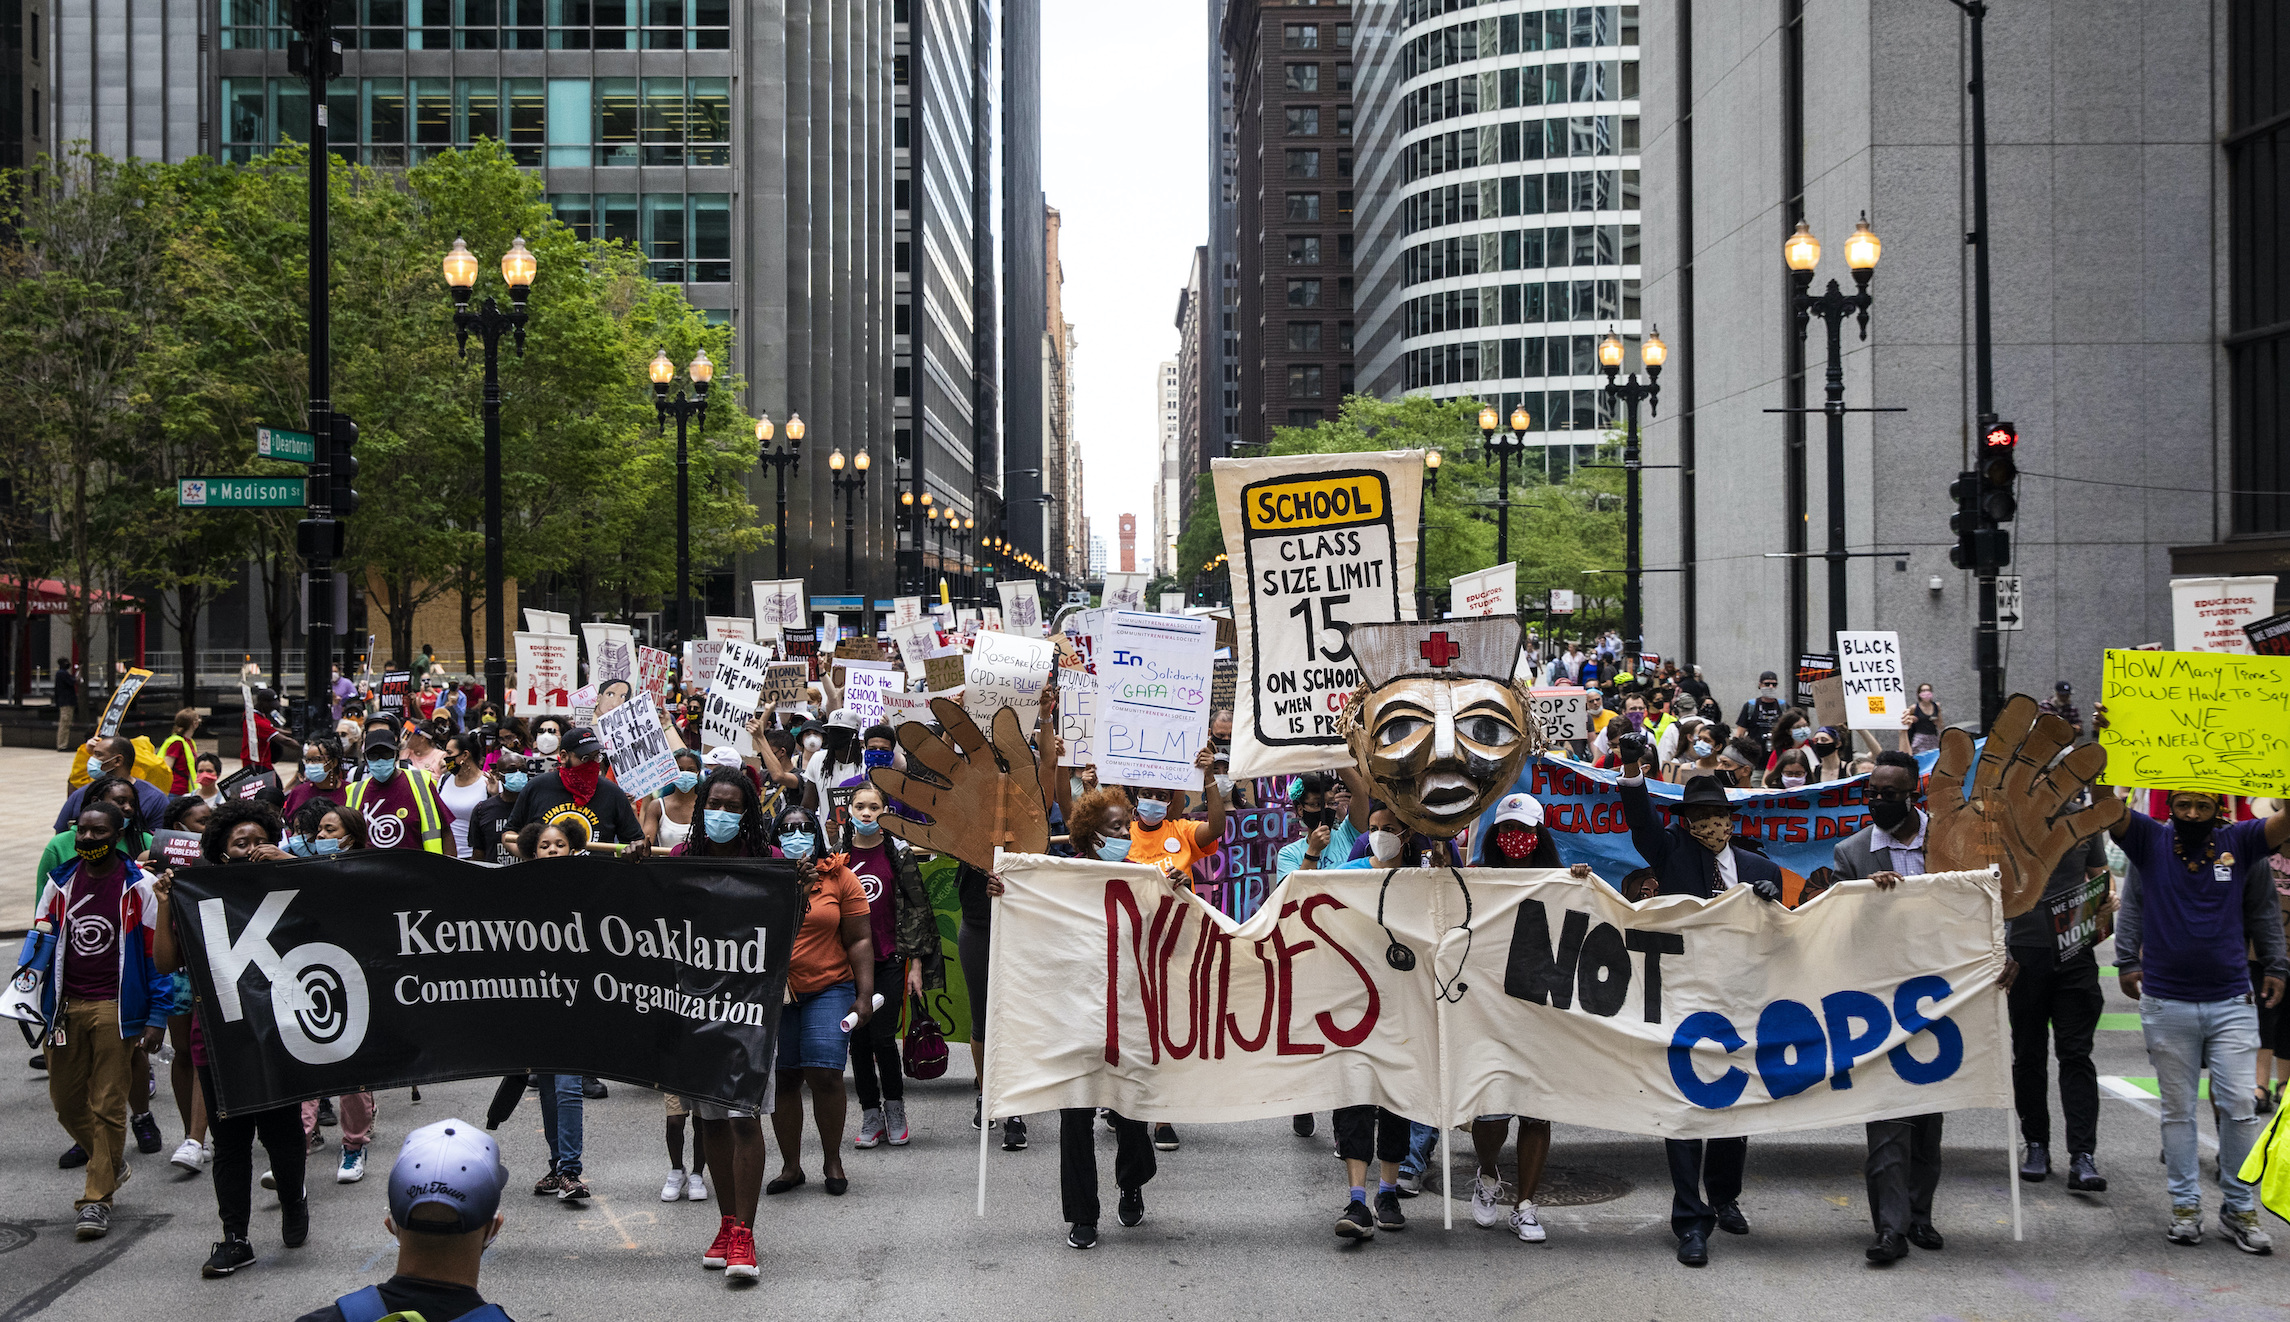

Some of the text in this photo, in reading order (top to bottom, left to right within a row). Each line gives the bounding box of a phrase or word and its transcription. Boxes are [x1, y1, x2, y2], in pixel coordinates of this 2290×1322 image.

[276, 434, 308, 455] Dearborn
[210, 483, 300, 500] W Madison St
[1257, 486, 1372, 524] SCHOOL
[1280, 531, 1361, 562] CLASS
[1263, 560, 1383, 596] SIZE LIMIT
[1998, 580, 2019, 592] ONE
[1466, 586, 1504, 603] EDUCATORS,
[1470, 596, 1502, 610] STUDENTS,
[1997, 596, 2020, 608] WAY
[2194, 597, 2256, 608] EDUCATORS,
[2199, 608, 2253, 618] STUDENTS,
[1290, 594, 1351, 662] 15
[2204, 629, 2246, 638] PARENTS
[2208, 640, 2243, 648] UNITED
[2252, 634, 2265, 642] WE
[786, 642, 814, 656] CPAC
[978, 636, 1014, 665] Roses
[1016, 660, 1029, 668] ARE
[1843, 640, 1895, 656] BLACK
[726, 641, 770, 676] WE HAVE
[1113, 650, 1143, 666] In
[1850, 660, 1895, 674] LIVES
[716, 664, 740, 690] THE
[854, 672, 892, 689] END the
[970, 668, 996, 686] CPD
[1013, 676, 1042, 690] BLUE
[1141, 661, 1204, 692] Solidarity
[2112, 654, 2282, 688] HOW Many Times
[382, 682, 408, 694] CPAC
[1267, 670, 1296, 694] ON
[1844, 677, 1903, 696] MATTER
[382, 694, 403, 707] NOW
[578, 690, 588, 699] NO
[848, 688, 879, 702] SCHOOL
[882, 694, 914, 708] EDUCATION
[974, 690, 998, 706] 33
[998, 696, 1041, 707] MILLION
[1123, 684, 1168, 698] GAPA
[1178, 687, 1204, 705] CPS
[2108, 681, 2289, 712] DO WE Have To Say
[1274, 696, 1312, 716] WHEN
[1289, 717, 1304, 734] IS
[2170, 708, 2228, 730] WE
[628, 719, 654, 740] the
[704, 720, 737, 745] BACK!
[1110, 724, 1202, 760] BLM!
[2262, 733, 2288, 752] in
[1122, 768, 1192, 782] GAPA NOW!
[246, 782, 256, 790] GOT
[833, 796, 846, 806] WE
[542, 802, 600, 826] JUNETEENTH
[164, 847, 200, 858] PROBLEMS
[170, 838, 173, 846] I
[188, 840, 199, 848] 99
[170, 857, 191, 866] AND...
[2050, 902, 2068, 916] WE
[2068, 883, 2106, 908] DEMAND
[393, 910, 767, 974] Kenwood Oakland
[2056, 915, 2097, 950] NOW
[1504, 898, 1685, 1024] NOT
[1104, 878, 1380, 1066] NURSES
[394, 970, 764, 1027] Community Organization
[1668, 975, 1964, 1110] COPS
[407, 1182, 467, 1202] Chi Town
